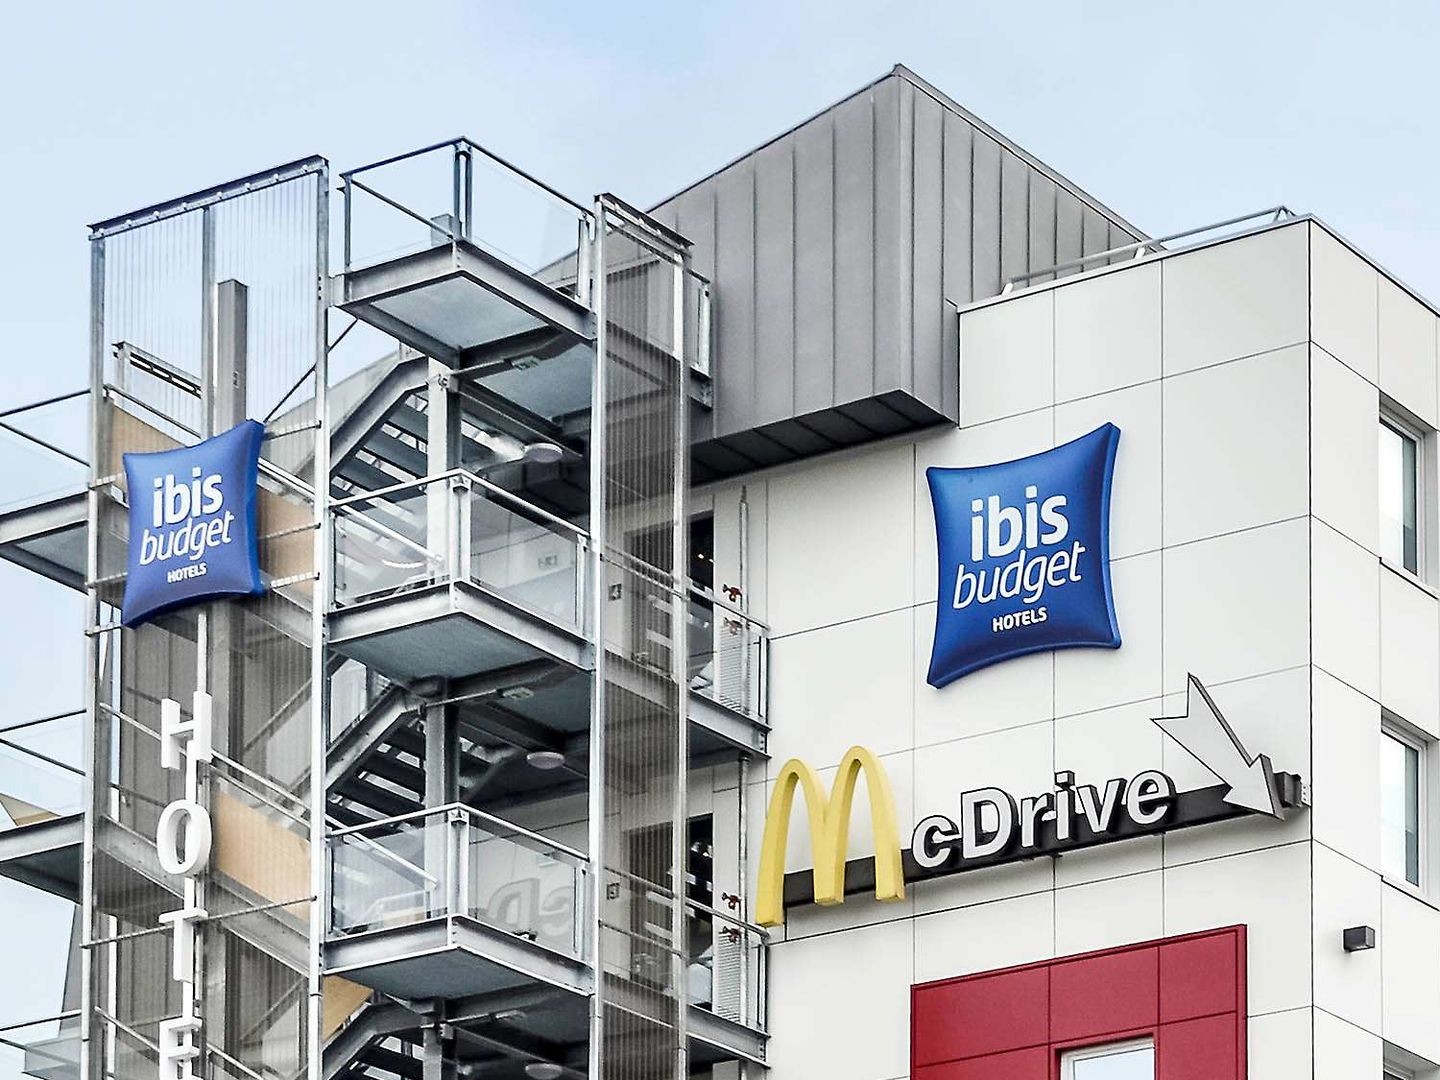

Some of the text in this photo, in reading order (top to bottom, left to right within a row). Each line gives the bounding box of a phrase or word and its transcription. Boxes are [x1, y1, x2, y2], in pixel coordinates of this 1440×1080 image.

[153, 466, 223, 528] ibis
[971, 485, 1069, 563] ibis
[139, 510, 235, 566] budget
[167, 562, 207, 584] HOTELS
[953, 540, 1086, 609] budget
[992, 606, 1048, 632] HOTELS
